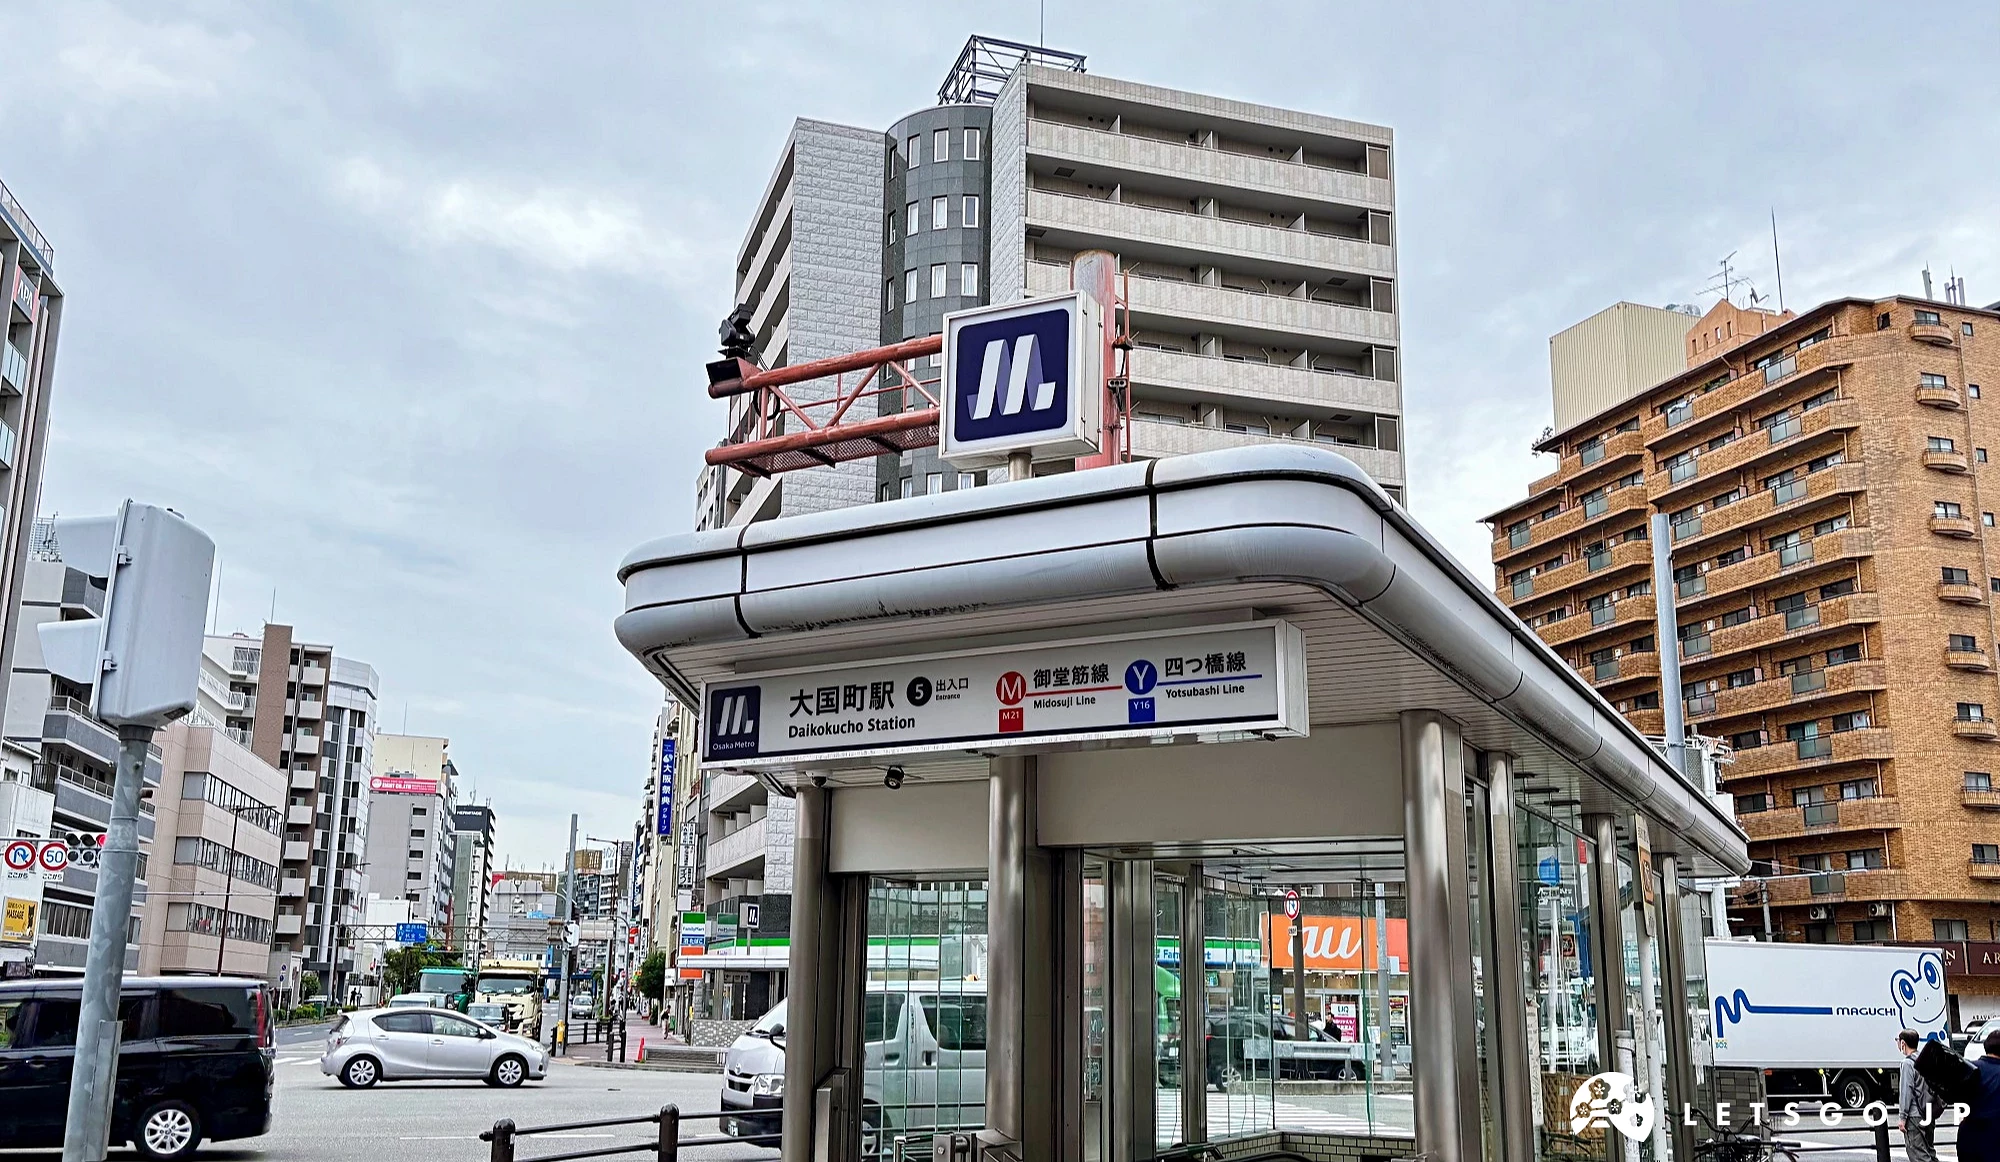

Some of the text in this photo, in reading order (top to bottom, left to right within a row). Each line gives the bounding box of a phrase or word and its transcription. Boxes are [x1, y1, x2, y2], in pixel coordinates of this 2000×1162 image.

[1164, 650, 1247, 677] 四つ橋線
[1033, 662, 1110, 689] 御堂筋線
[1132, 664, 1149, 690] Y
[914, 683, 925, 700] 5
[935, 677, 969, 692] 出入口
[1001, 676, 1022, 701] M
[1165, 683, 1245, 699] Yotsubashi Line
[789, 680, 895, 718] 大国町駅
[935, 692, 961, 701] Entrance
[1033, 695, 1096, 710] Midosuji Line
[1133, 701, 1150, 711] Y16
[1002, 710, 1020, 721] M21
[788, 716, 916, 739] Daikokucho Station
[712, 740, 755, 751] Osaka Metro
[46, 850, 64, 863] 50
[1287, 925, 1362, 960] au
[1836, 1006, 1896, 1017] MAGUCHI
